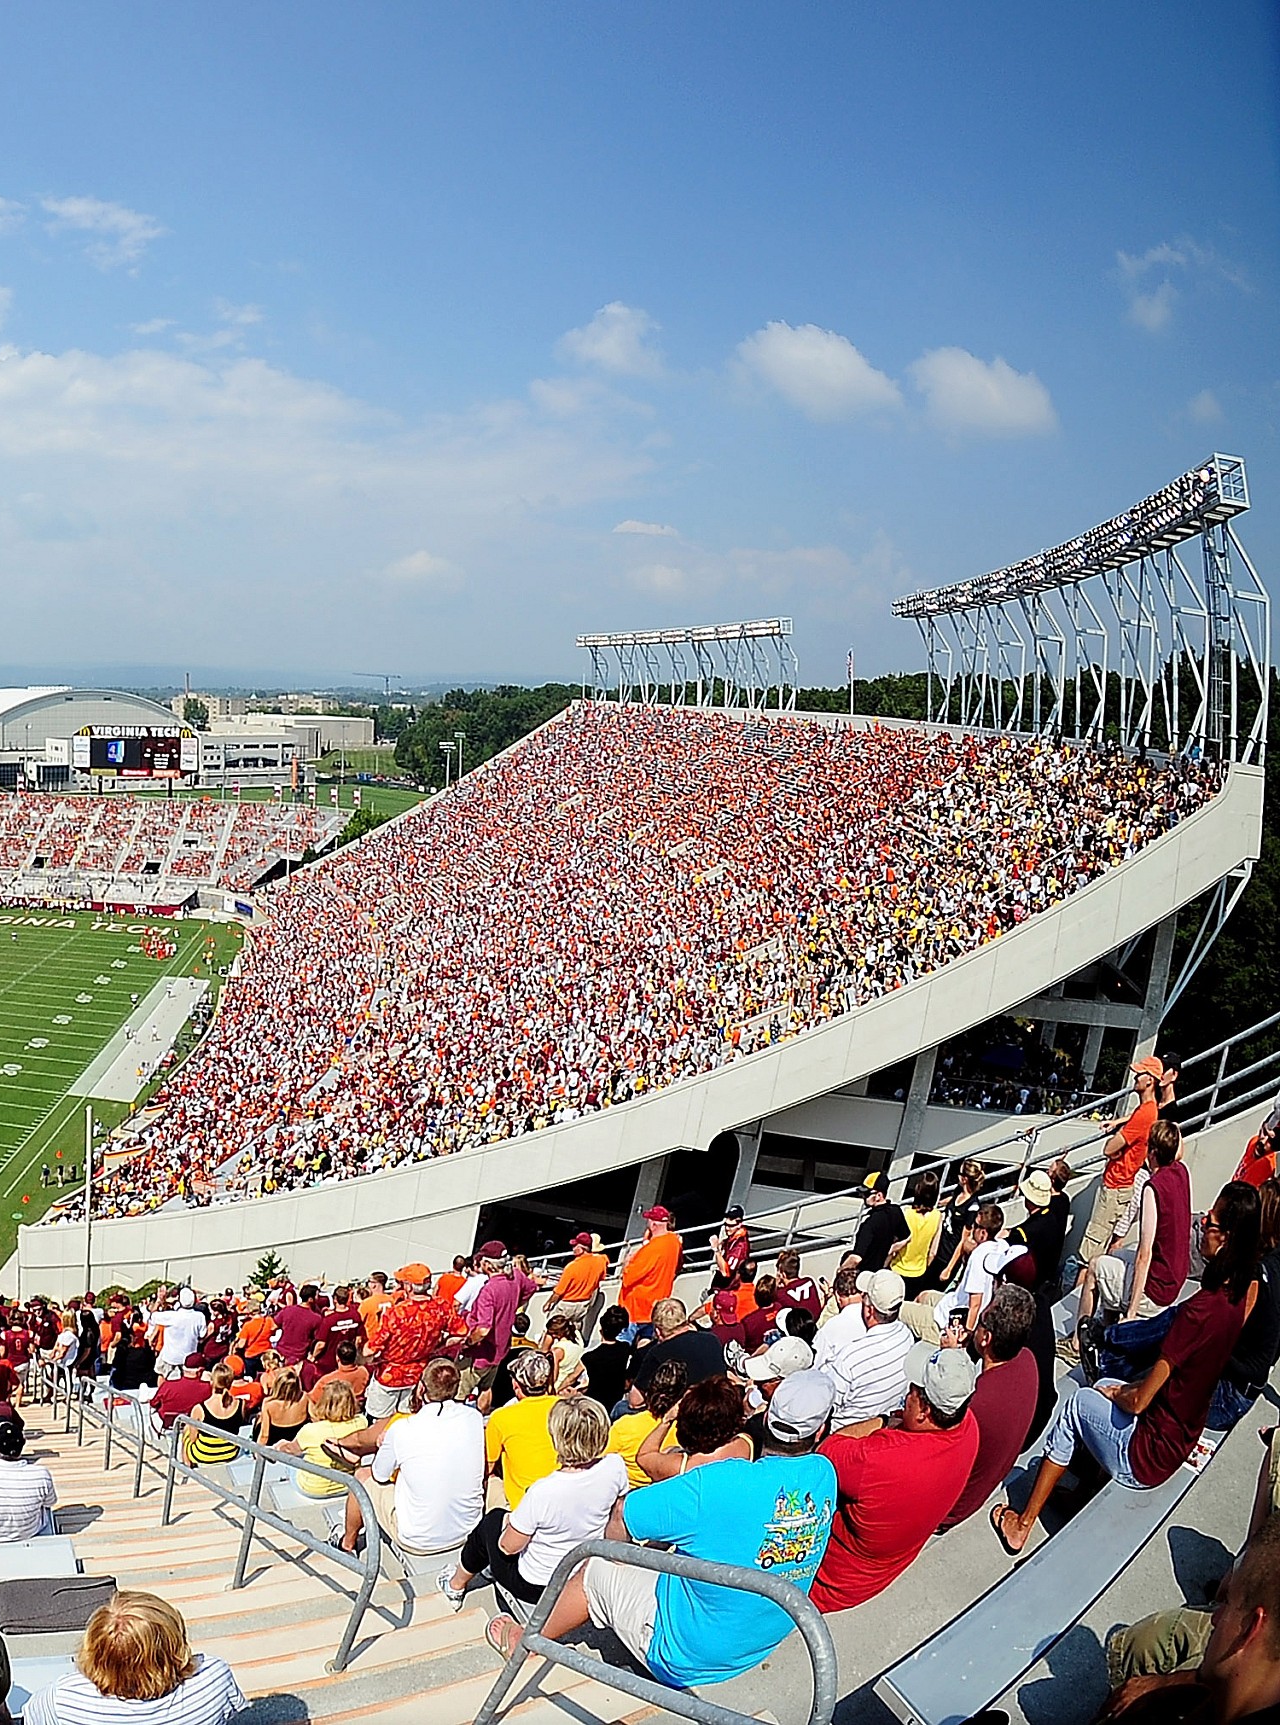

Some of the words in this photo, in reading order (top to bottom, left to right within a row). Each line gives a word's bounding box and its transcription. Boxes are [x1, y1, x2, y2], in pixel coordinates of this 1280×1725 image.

[91, 726, 149, 737] VIRGINIA
[150, 727, 180, 738] TECH
[90, 921, 173, 936] TECH
[787, 1281, 813, 1302] VT
